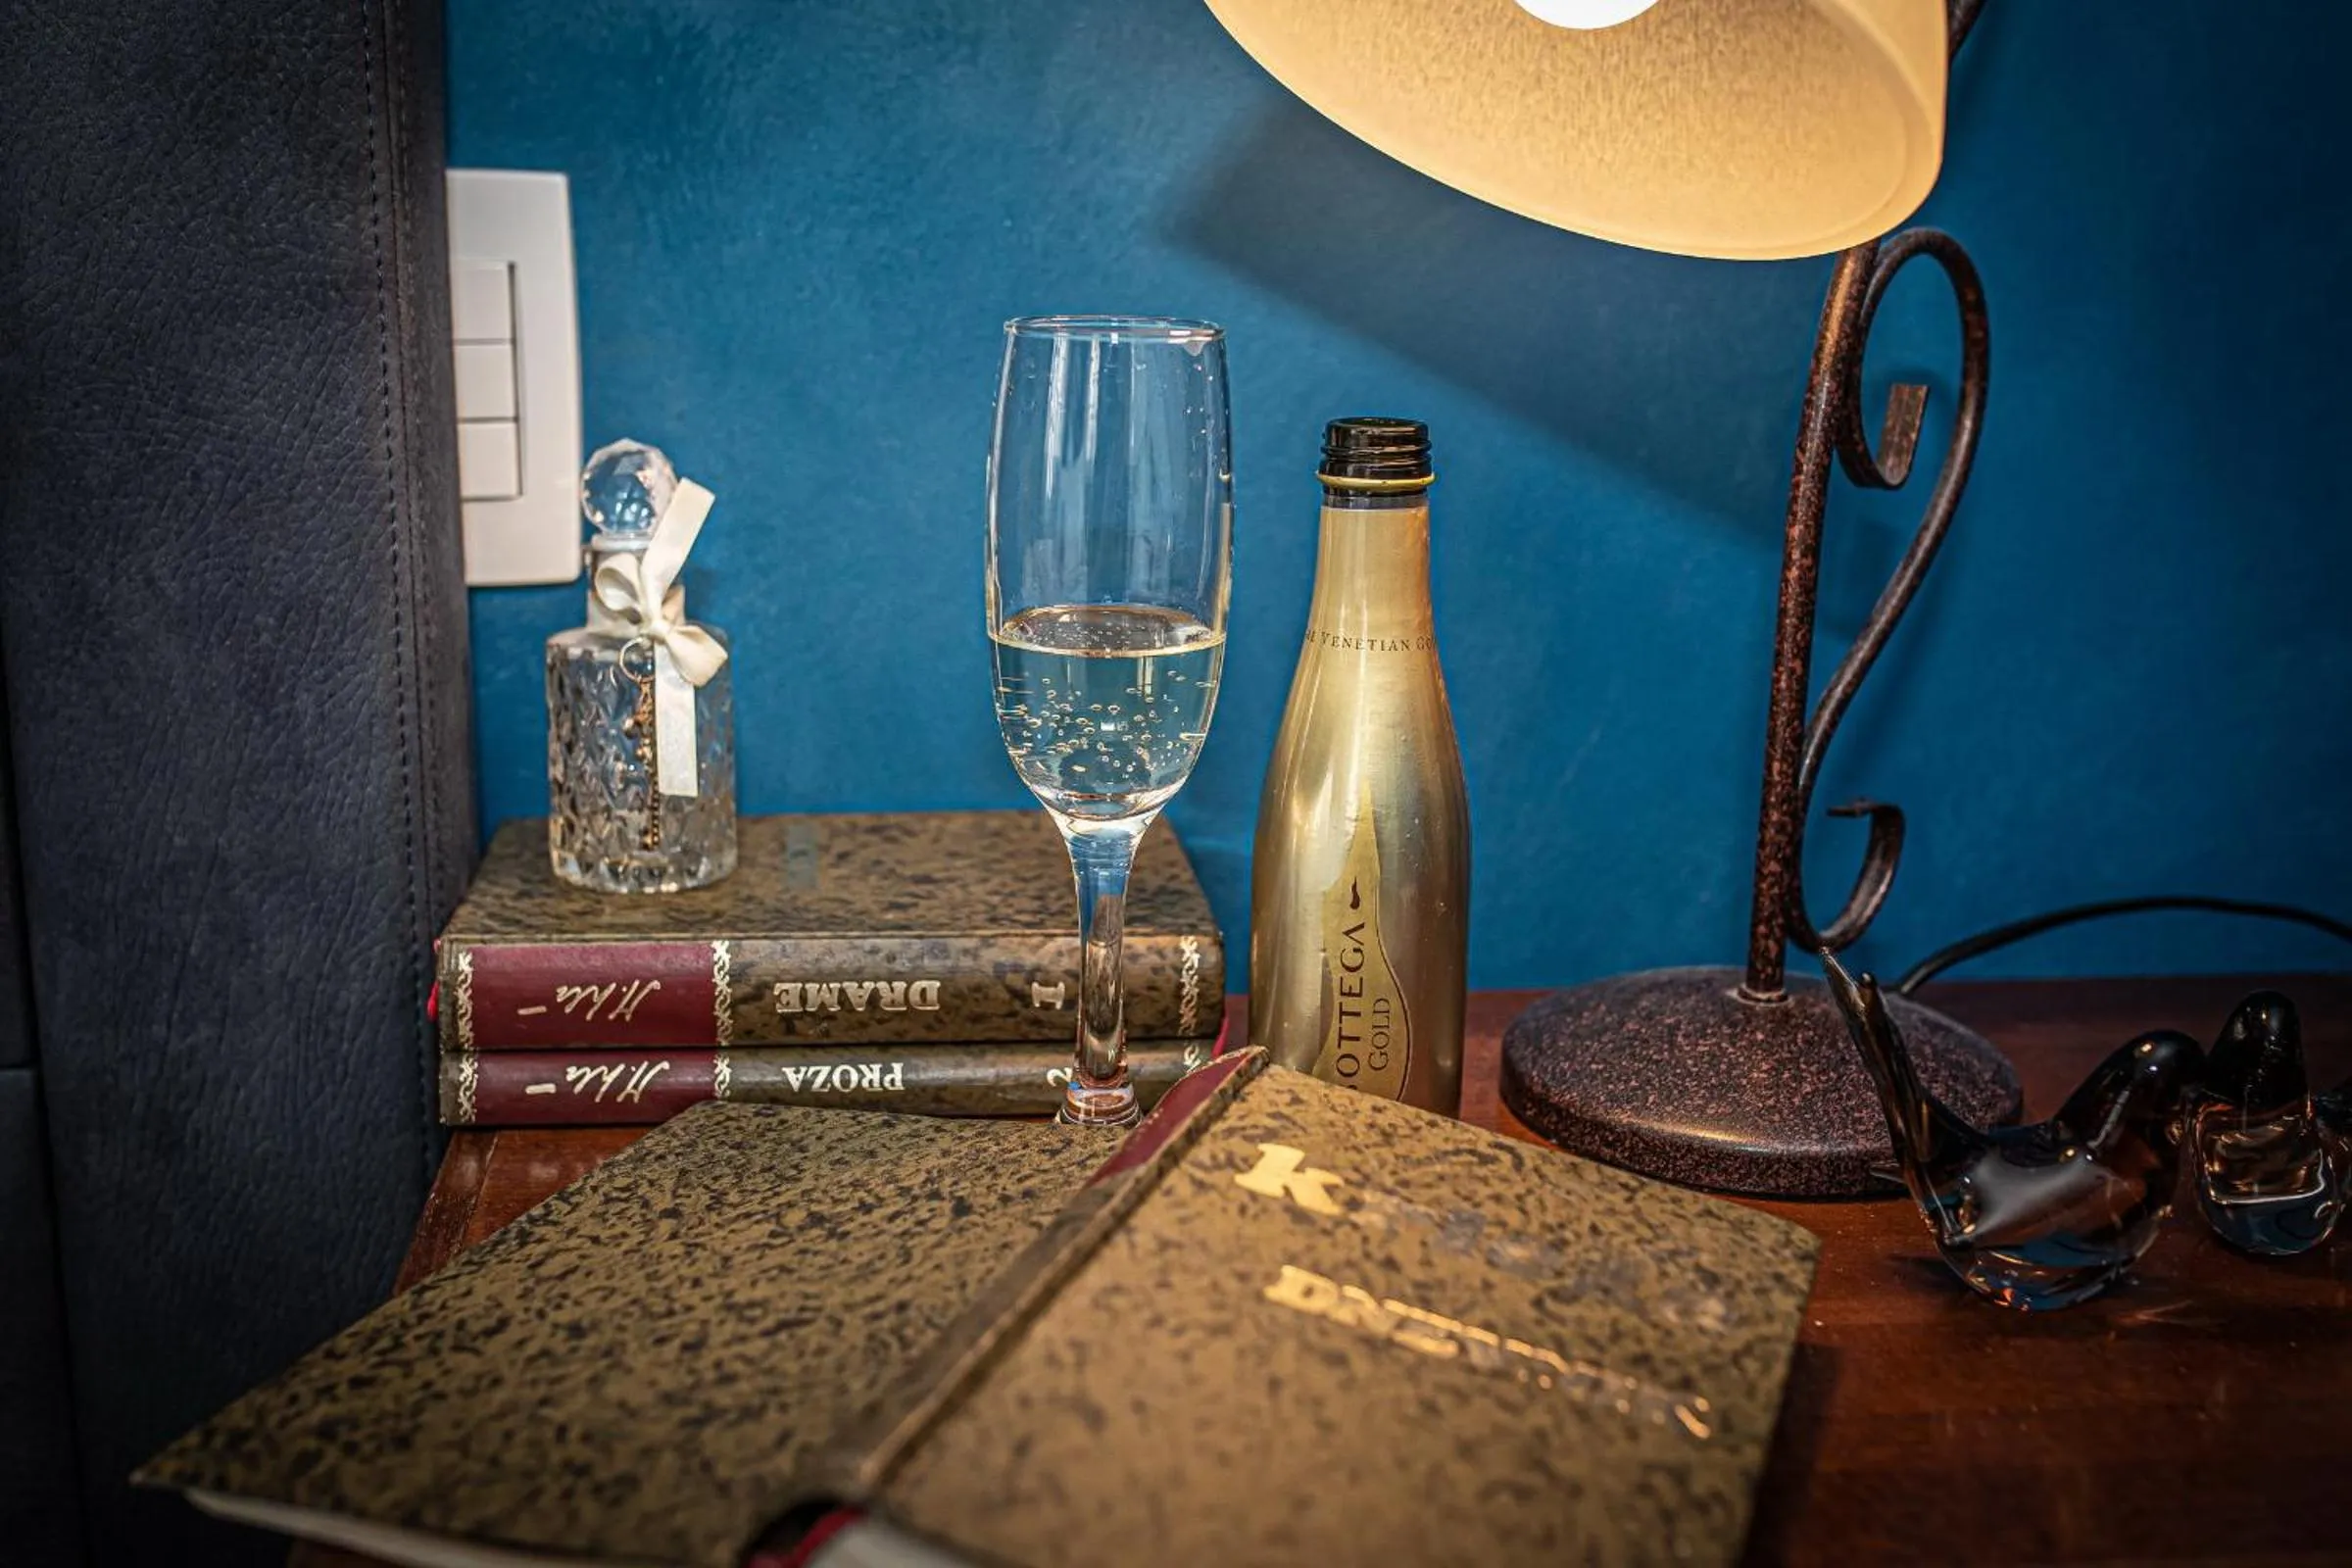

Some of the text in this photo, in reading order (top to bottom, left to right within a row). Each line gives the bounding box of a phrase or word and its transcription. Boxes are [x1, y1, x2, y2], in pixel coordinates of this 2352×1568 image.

[1320, 630, 1411, 652] VENETIAN
[773, 979, 942, 1013] DRAME
[1335, 921, 1365, 1090] OTTEGA
[1367, 997, 1391, 1071] GOLD
[781, 1061, 906, 1093] PROZA
